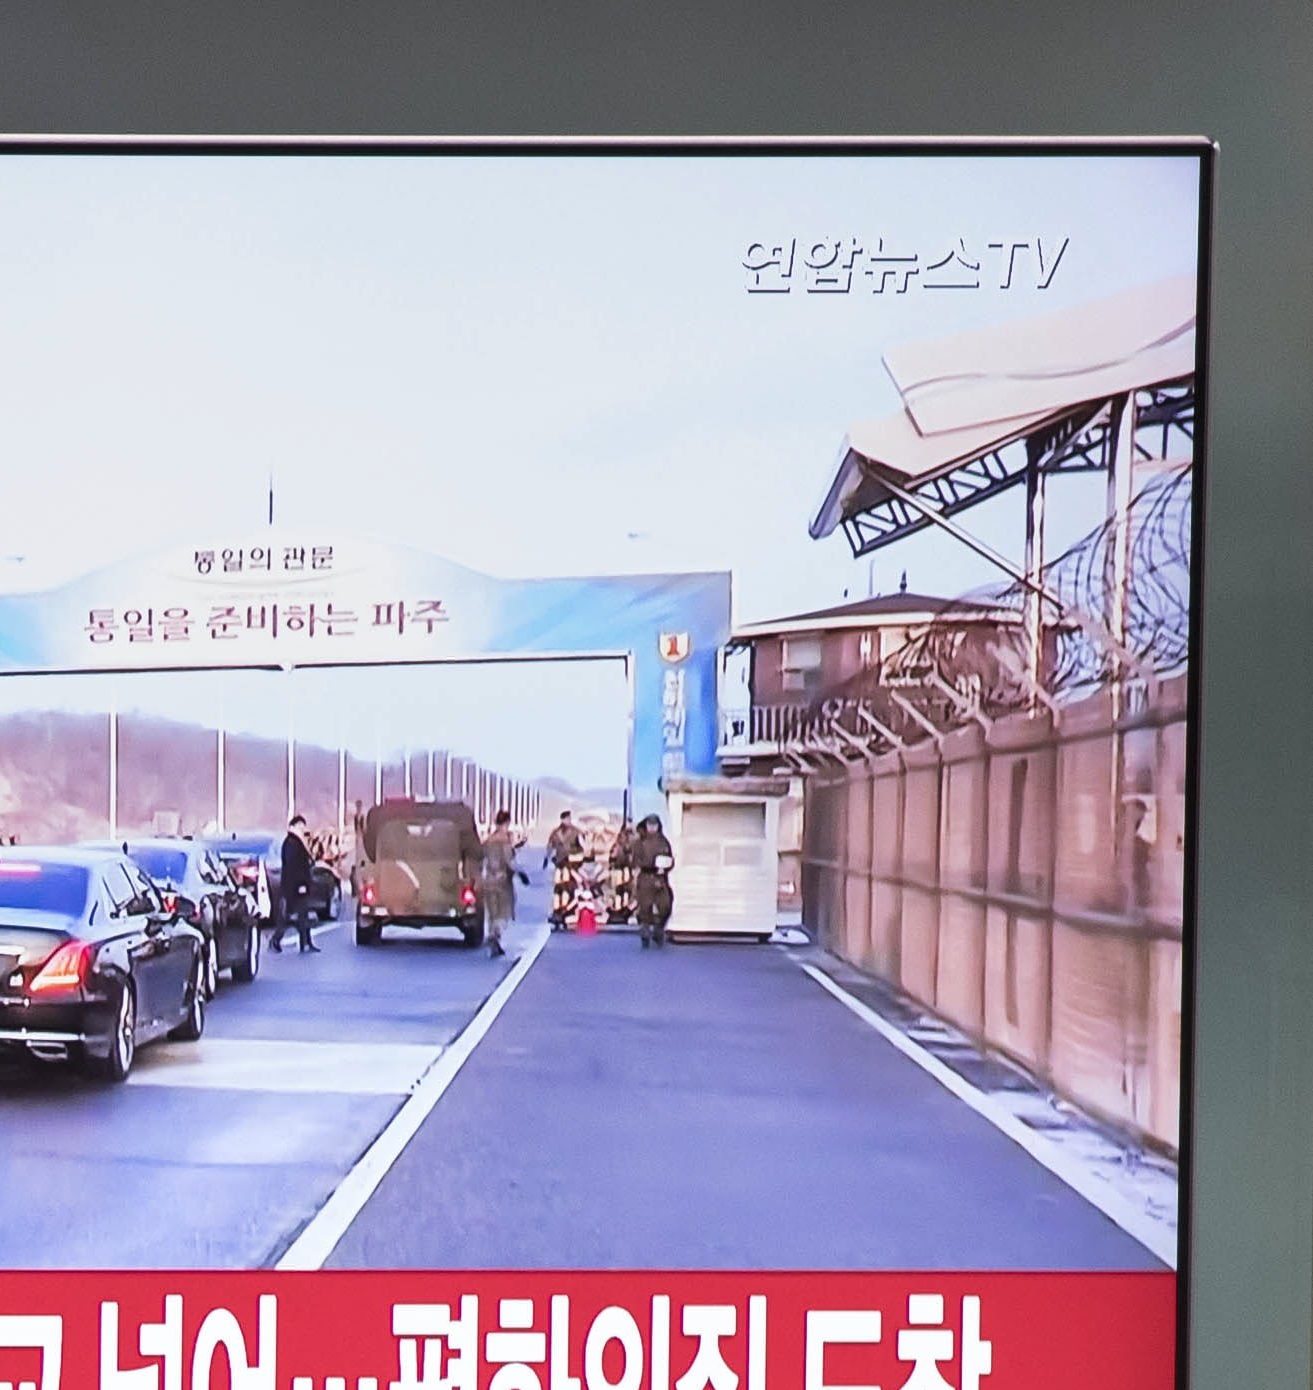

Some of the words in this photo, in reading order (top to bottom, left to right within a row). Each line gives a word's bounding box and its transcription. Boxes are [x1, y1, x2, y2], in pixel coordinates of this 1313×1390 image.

[741, 235, 1071, 294] 연합뉴스TV
[83, 607, 196, 643] 통일을
[205, 602, 359, 640] 준비하는
[370, 599, 450, 636] 파주
